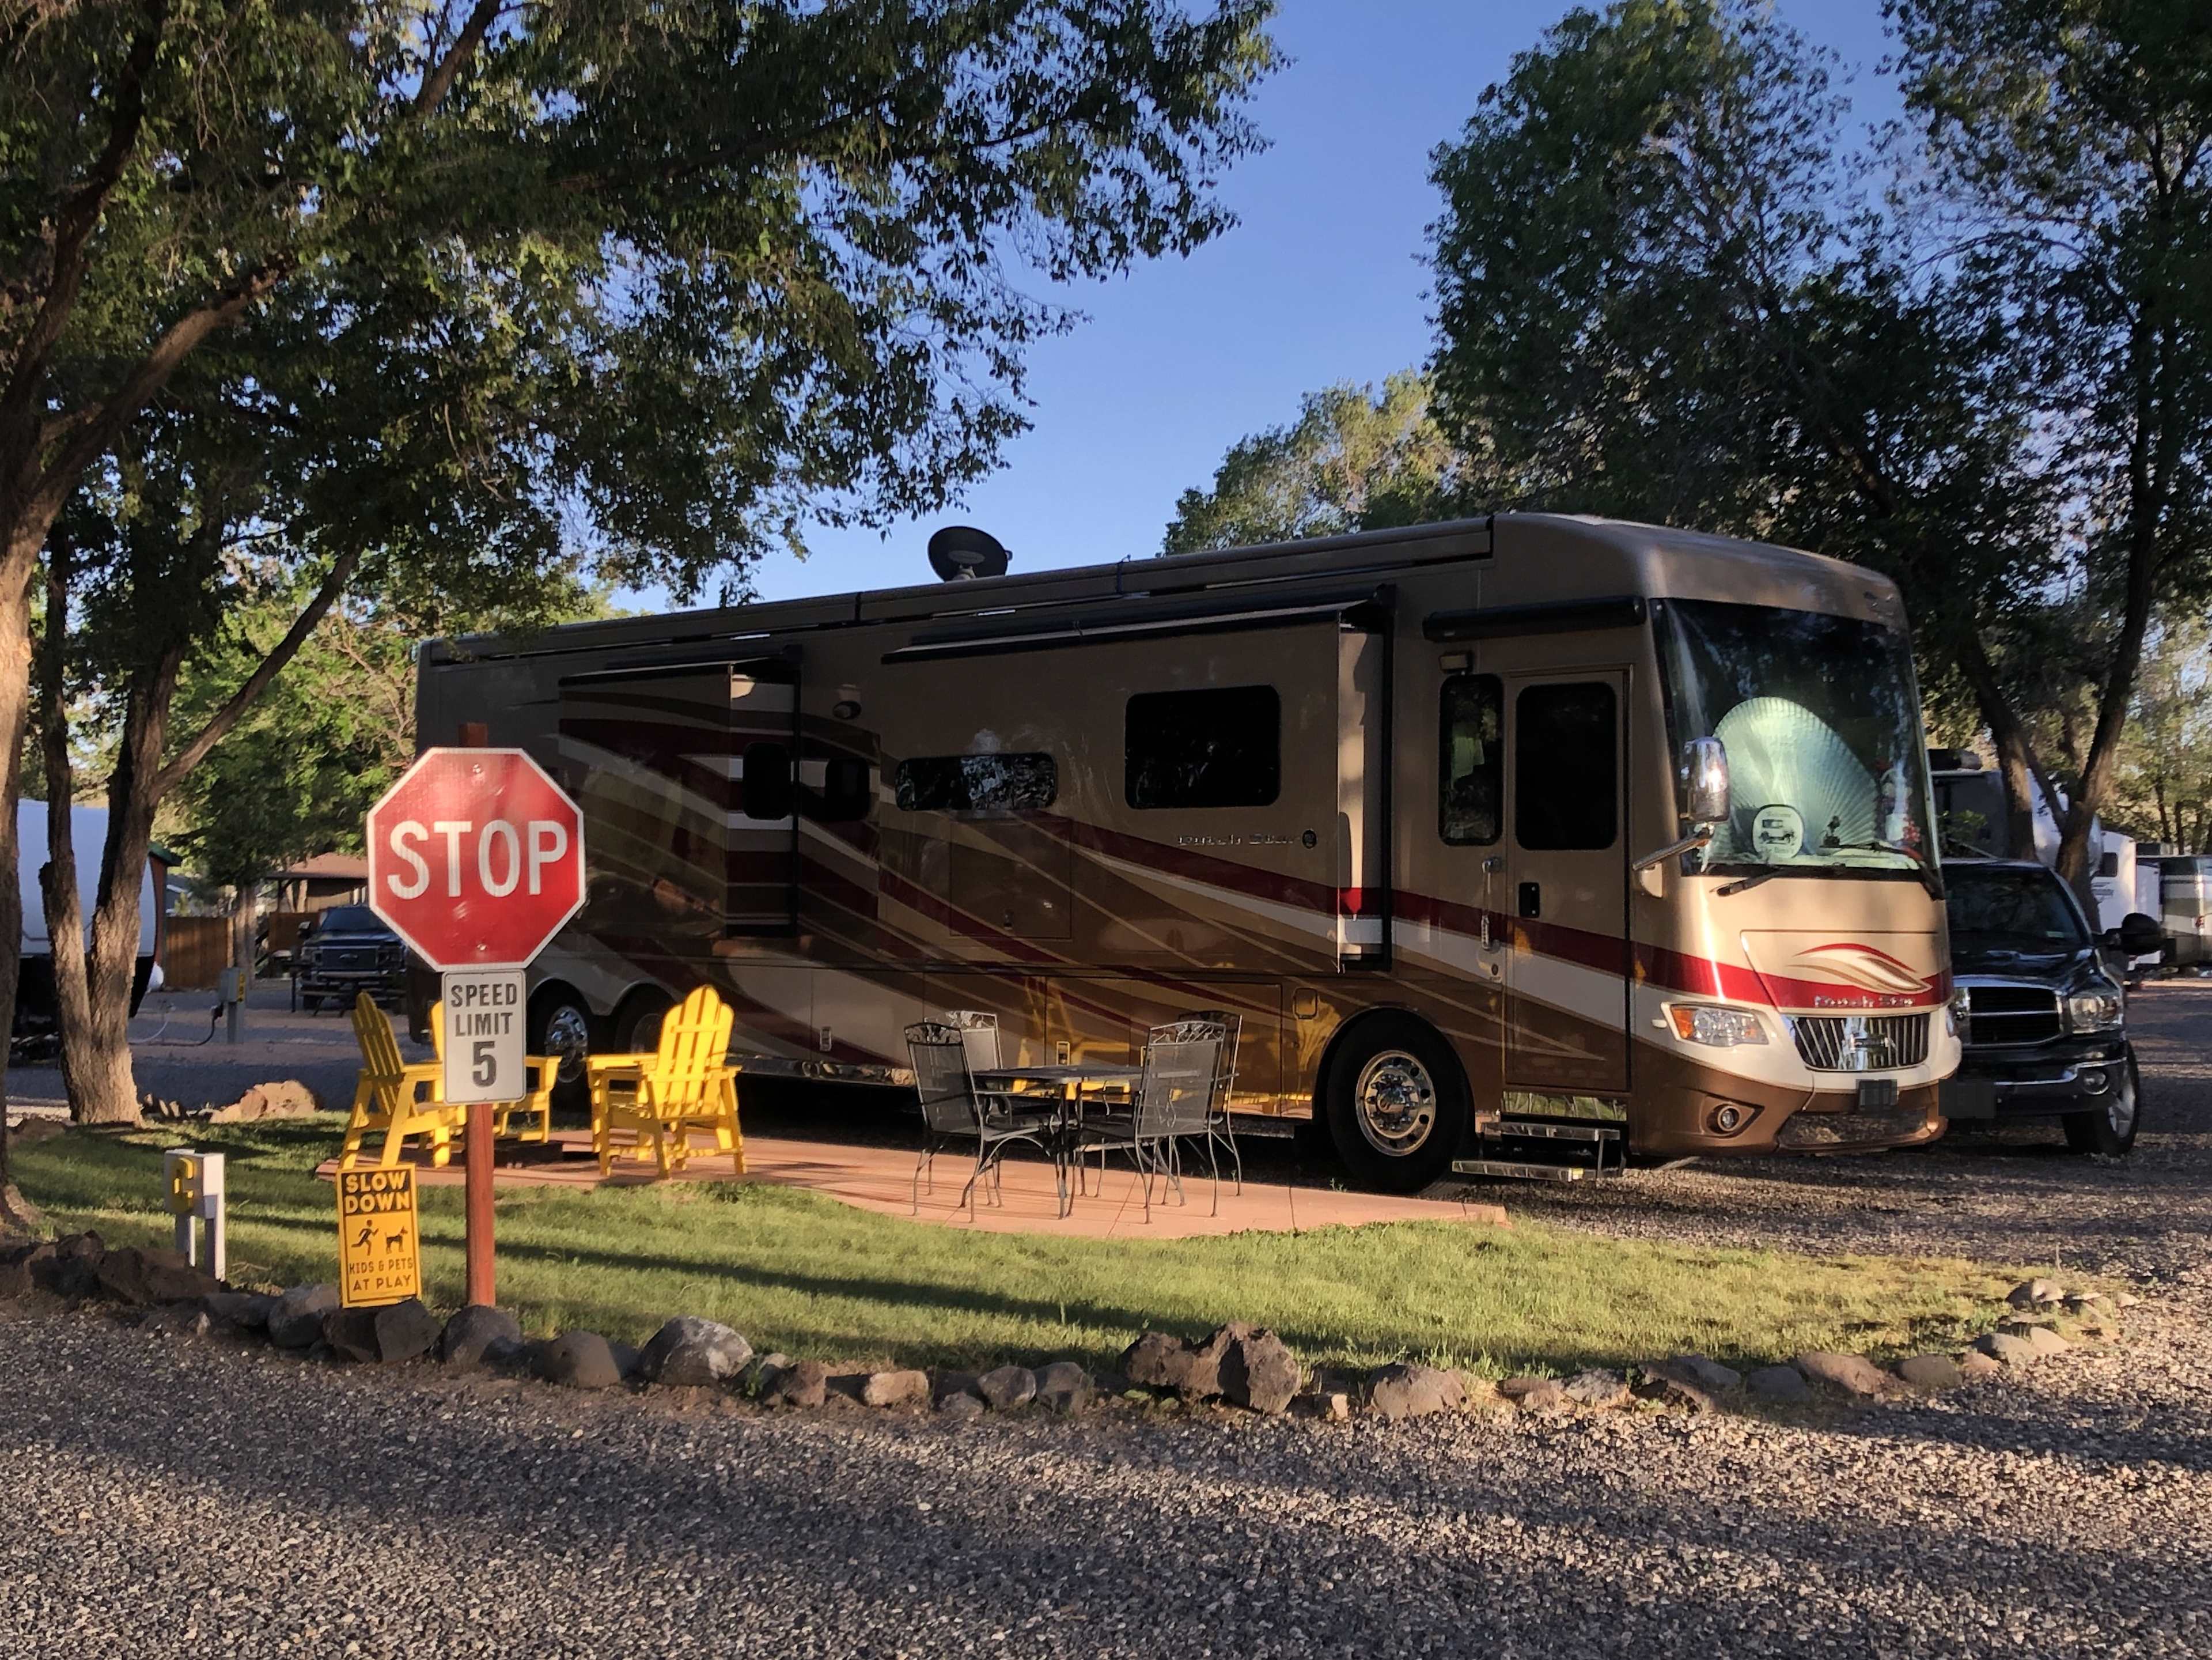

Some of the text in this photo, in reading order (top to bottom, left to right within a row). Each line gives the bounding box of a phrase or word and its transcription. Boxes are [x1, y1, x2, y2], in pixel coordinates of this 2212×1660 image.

[387, 820, 568, 899] STOP
[451, 983, 517, 1007] SPEED
[455, 1012, 513, 1037] LIMIT
[472, 1041, 497, 1087] 5
[346, 1171, 406, 1193] SLOW
[344, 1191, 410, 1213] DOWN
[348, 1257, 414, 1275] KIDS & PETS
[353, 1274, 412, 1292] AT PLAY
